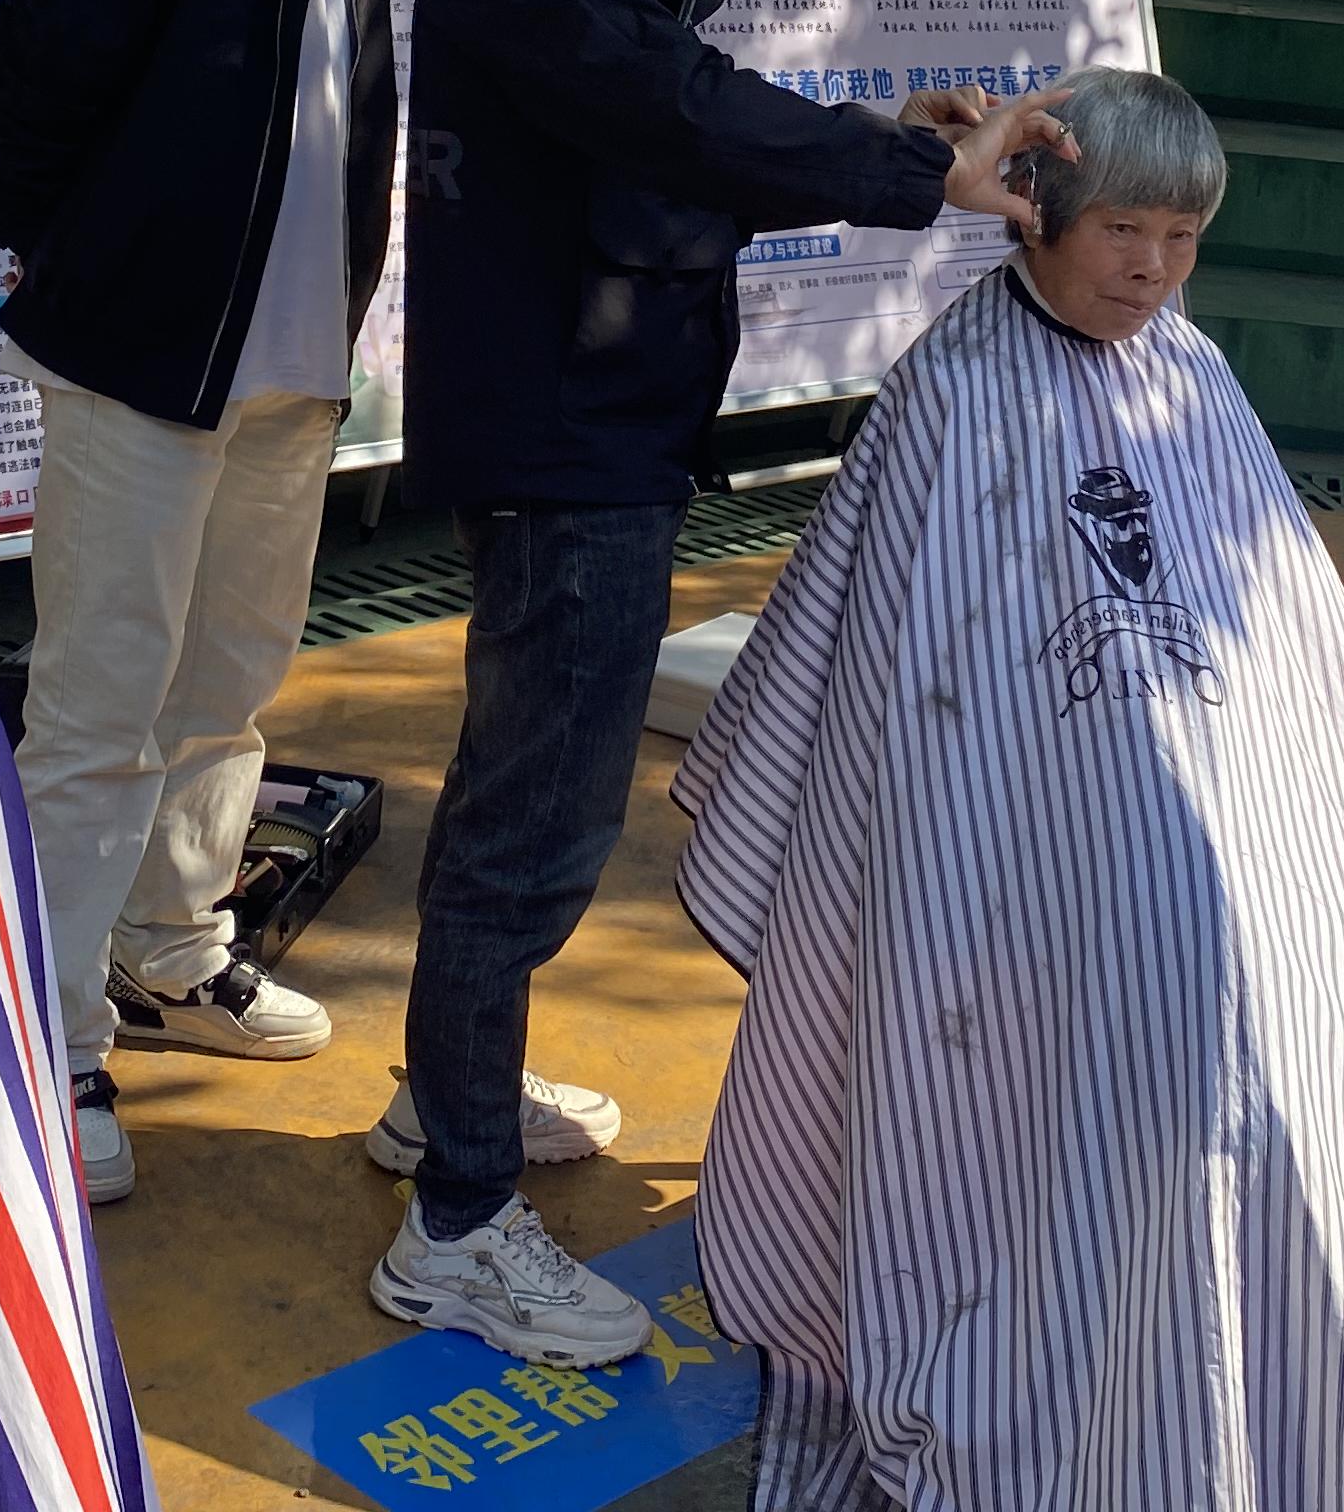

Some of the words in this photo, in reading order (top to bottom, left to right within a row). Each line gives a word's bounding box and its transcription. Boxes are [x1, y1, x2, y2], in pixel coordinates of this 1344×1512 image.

[759, 68, 895, 101] 连着你我他
